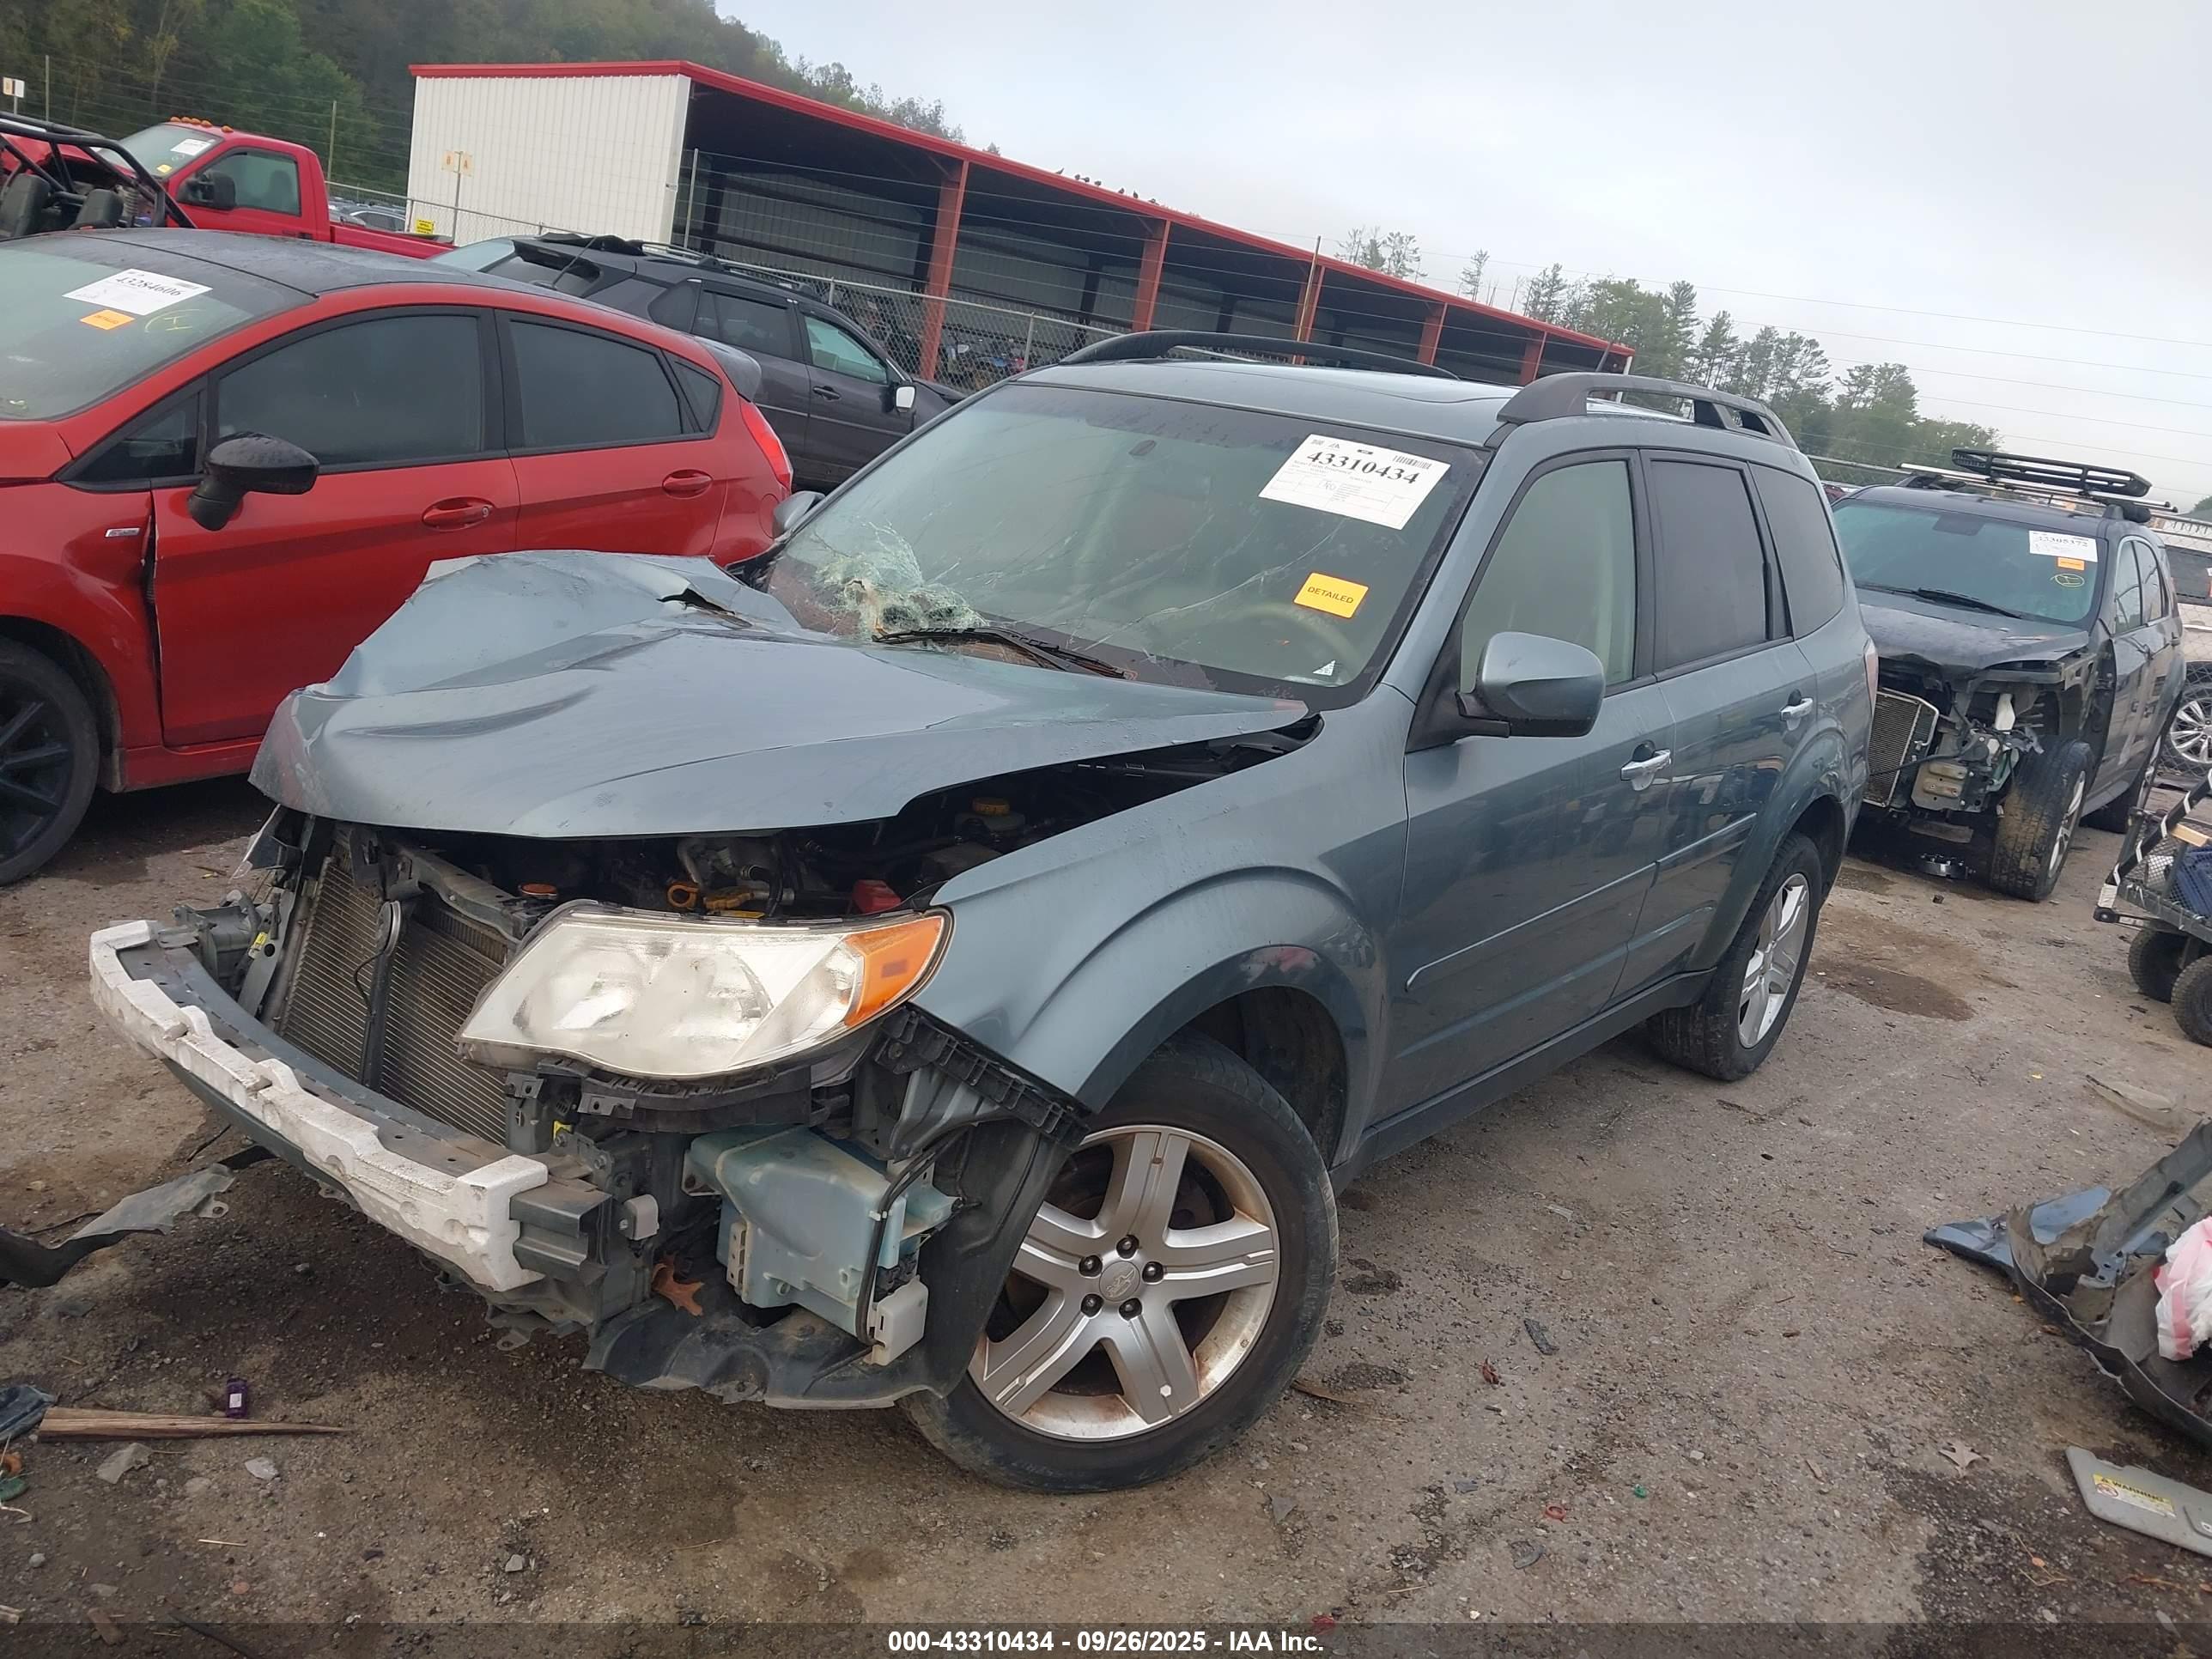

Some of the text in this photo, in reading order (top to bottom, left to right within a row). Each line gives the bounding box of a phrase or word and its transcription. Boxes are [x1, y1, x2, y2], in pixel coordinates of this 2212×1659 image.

[1306, 451, 1421, 484] 43310434
[1307, 586, 1354, 604] DETAILED
[2112, 1480, 2165, 1503] WARNING
